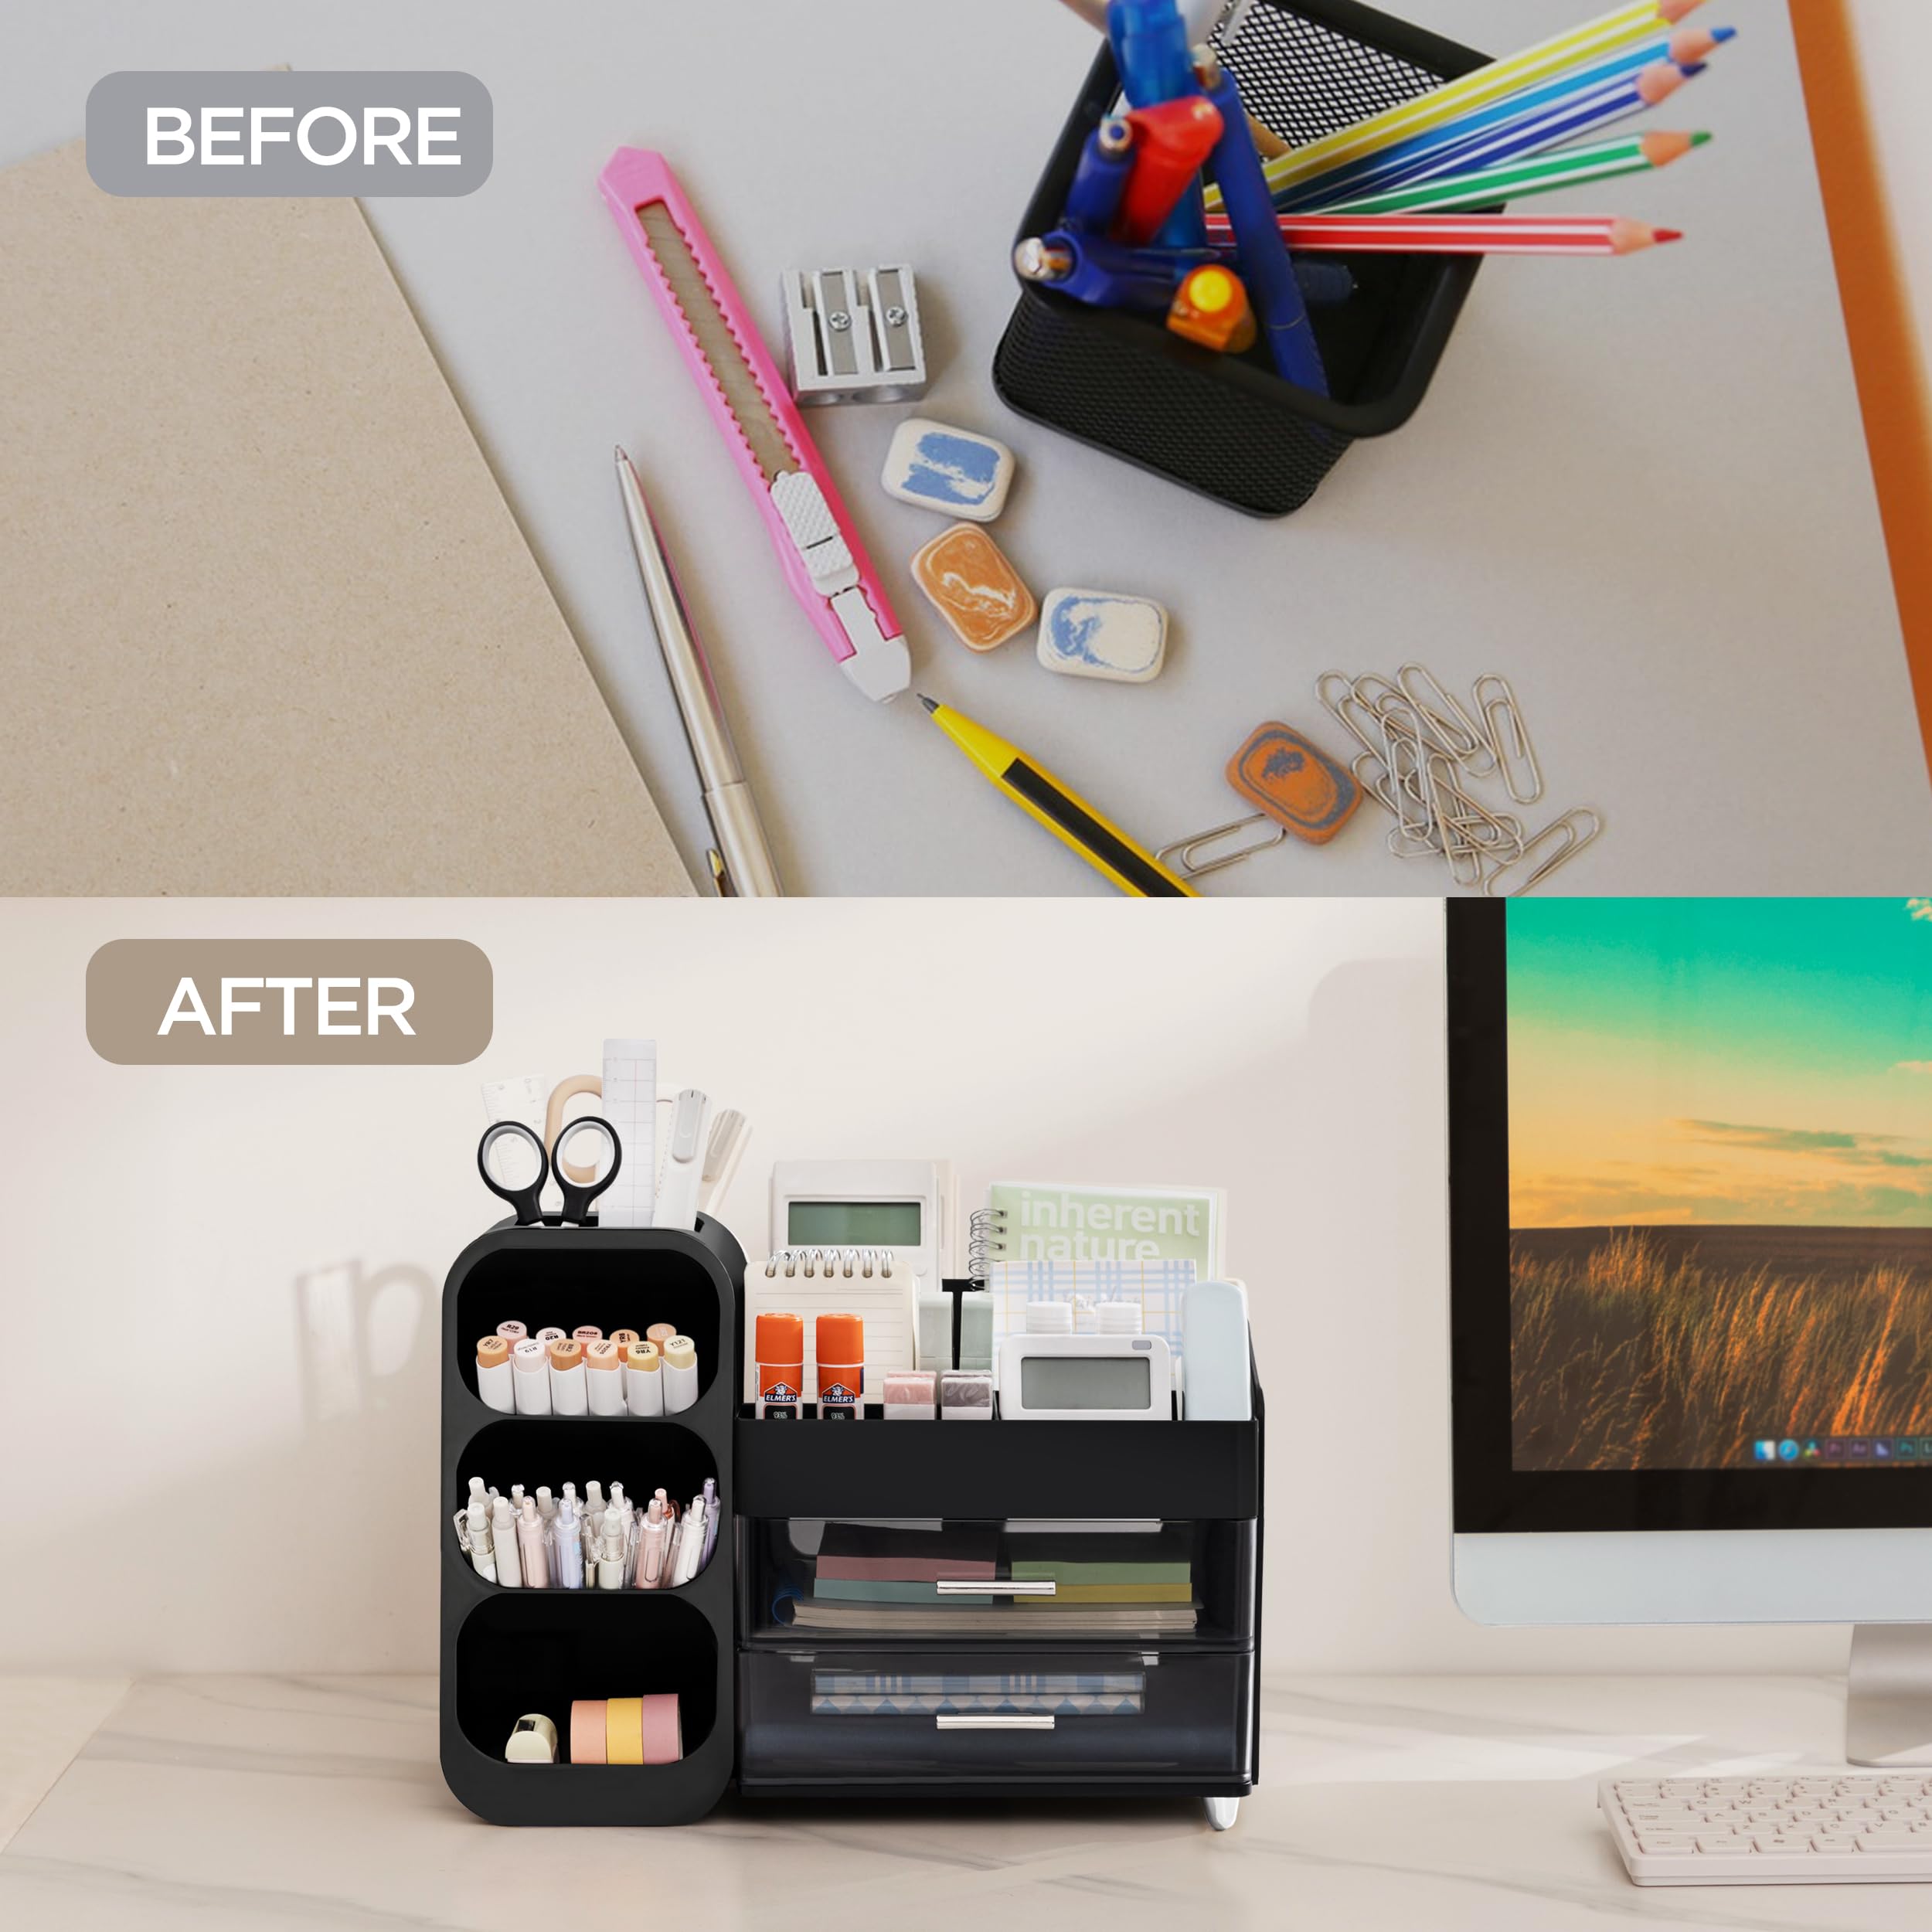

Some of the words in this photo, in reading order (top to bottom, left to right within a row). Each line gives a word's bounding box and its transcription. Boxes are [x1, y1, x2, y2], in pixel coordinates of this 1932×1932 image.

[1019, 1190, 1200, 1236] inherent
[1019, 1230, 1160, 1261] nature
[766, 1393, 797, 1403] ELMER'S
[823, 1394, 854, 1403] ELMER'S
